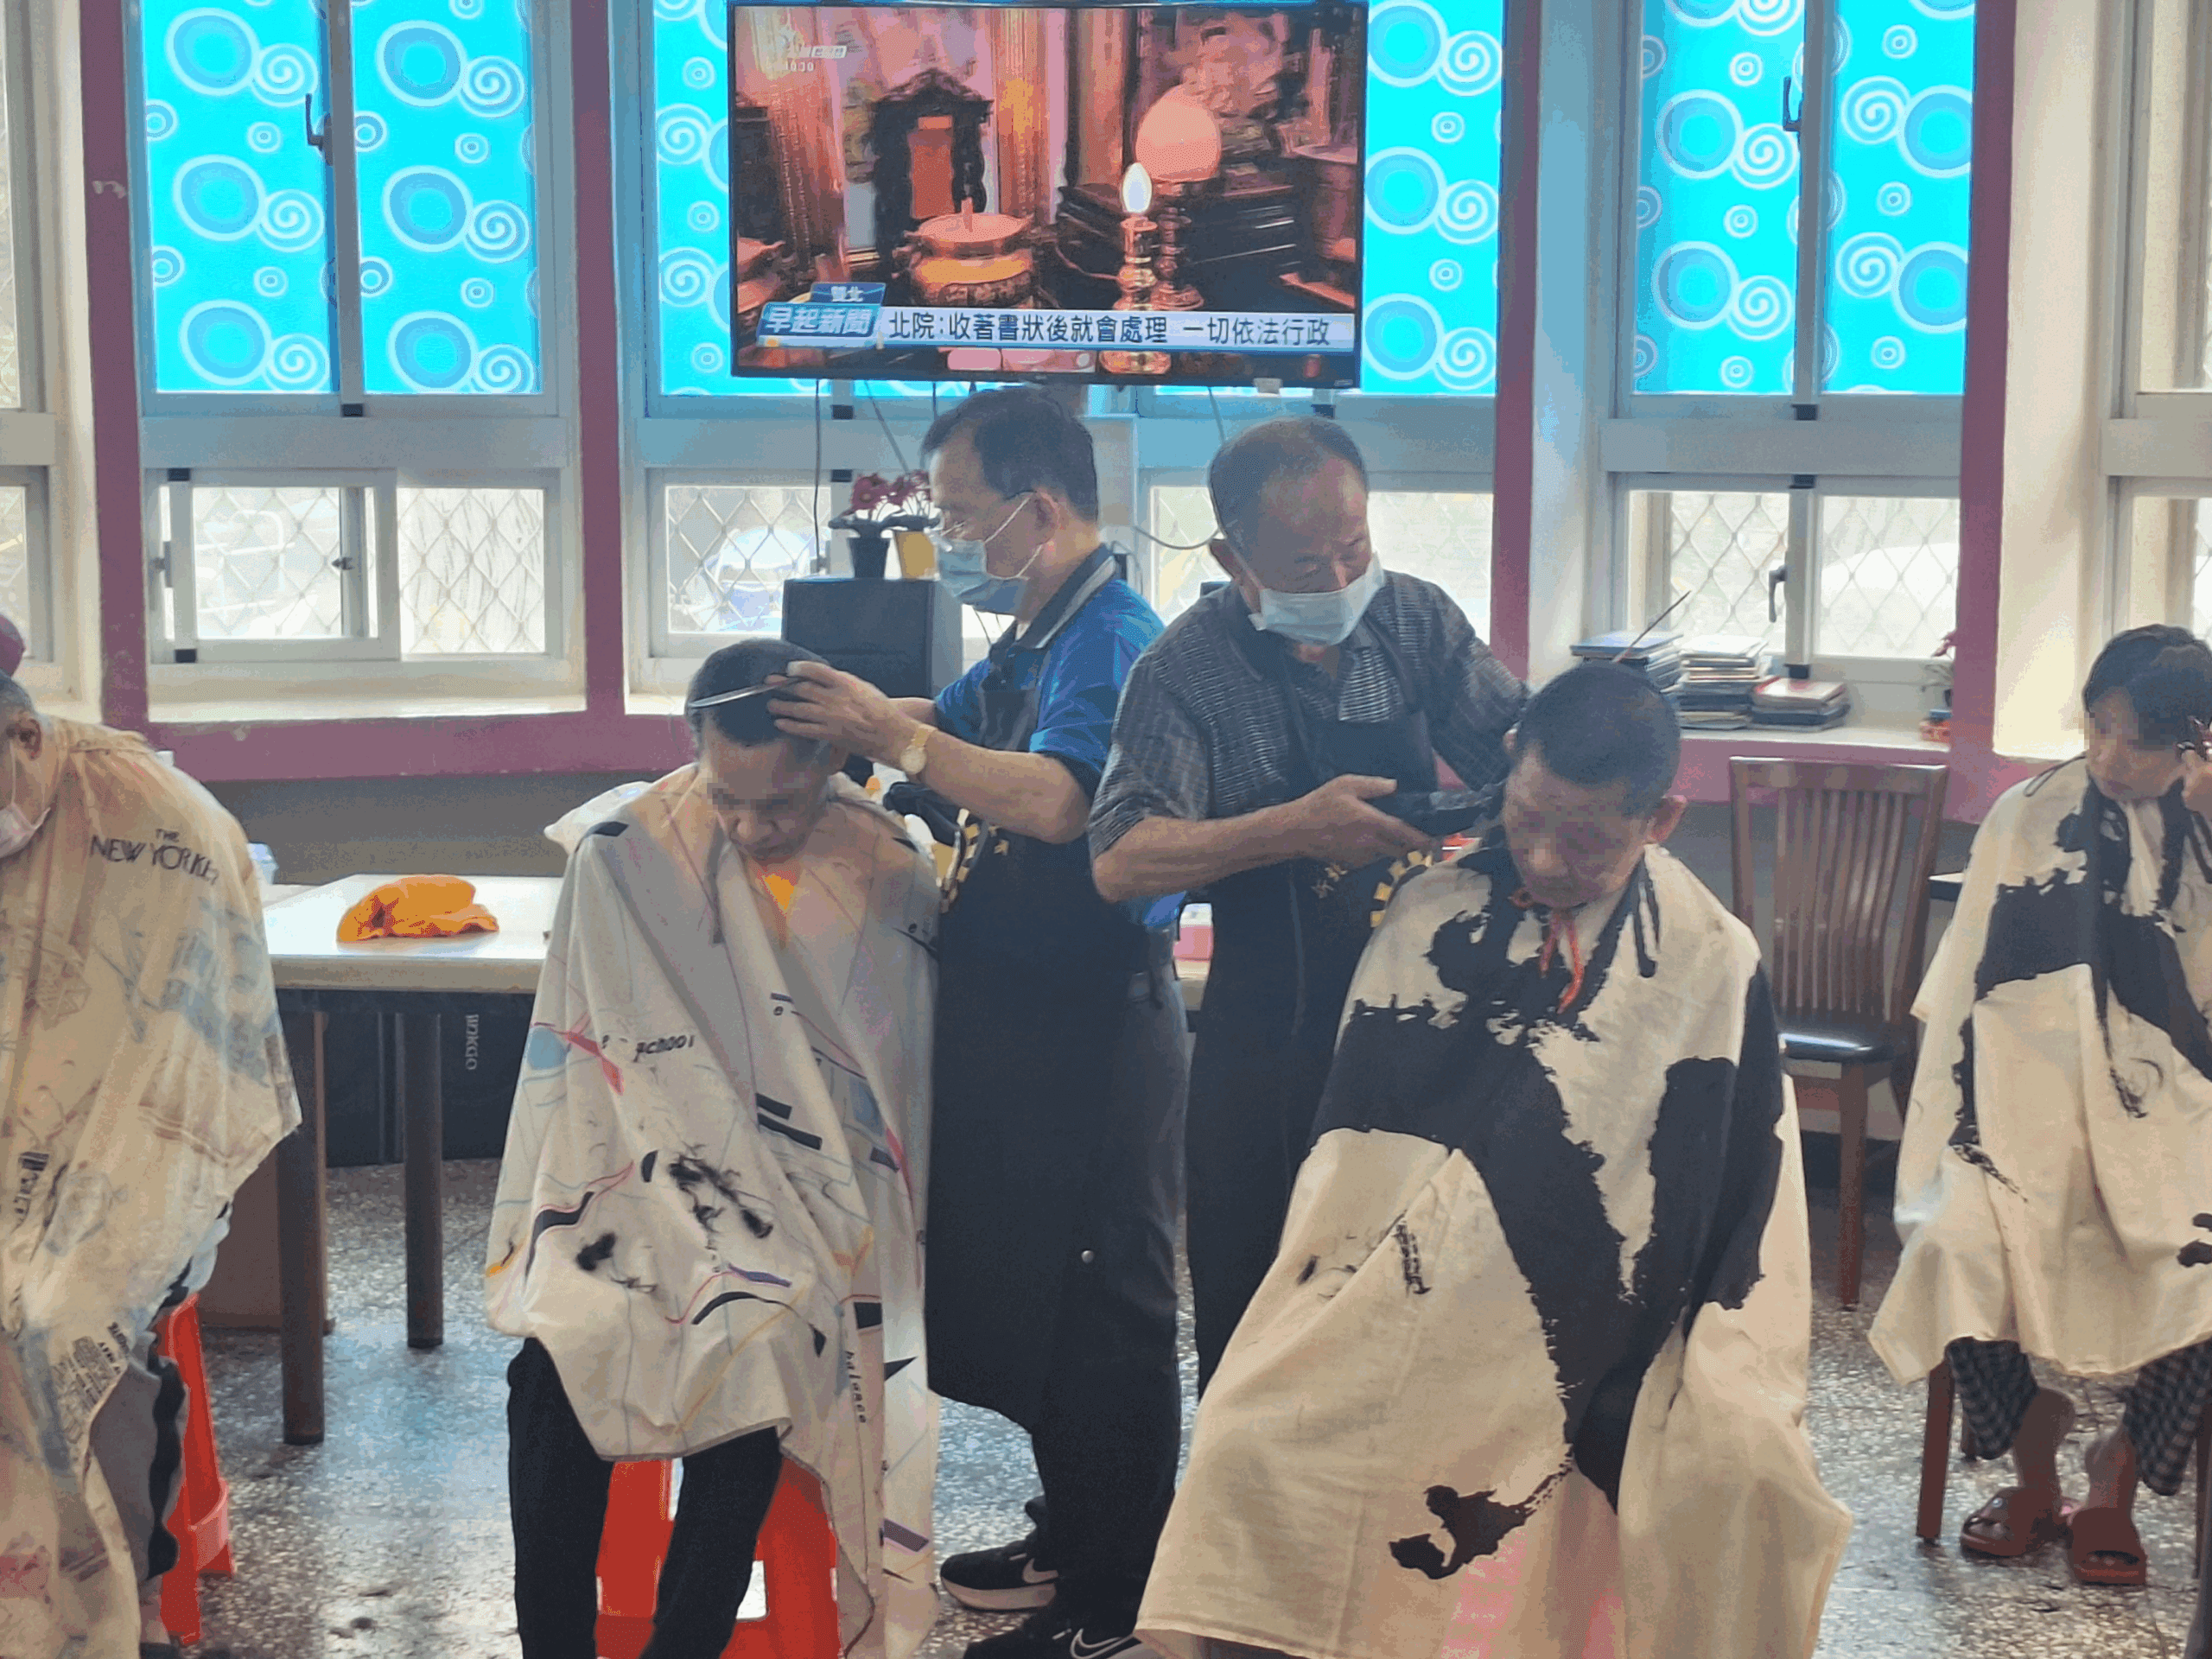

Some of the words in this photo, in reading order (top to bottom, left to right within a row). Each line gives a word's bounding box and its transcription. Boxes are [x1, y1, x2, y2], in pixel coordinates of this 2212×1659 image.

[765, 306, 873, 334] 早起新聞
[1183, 316, 1330, 346] 一切依法行政
[89, 834, 147, 862] NEW
